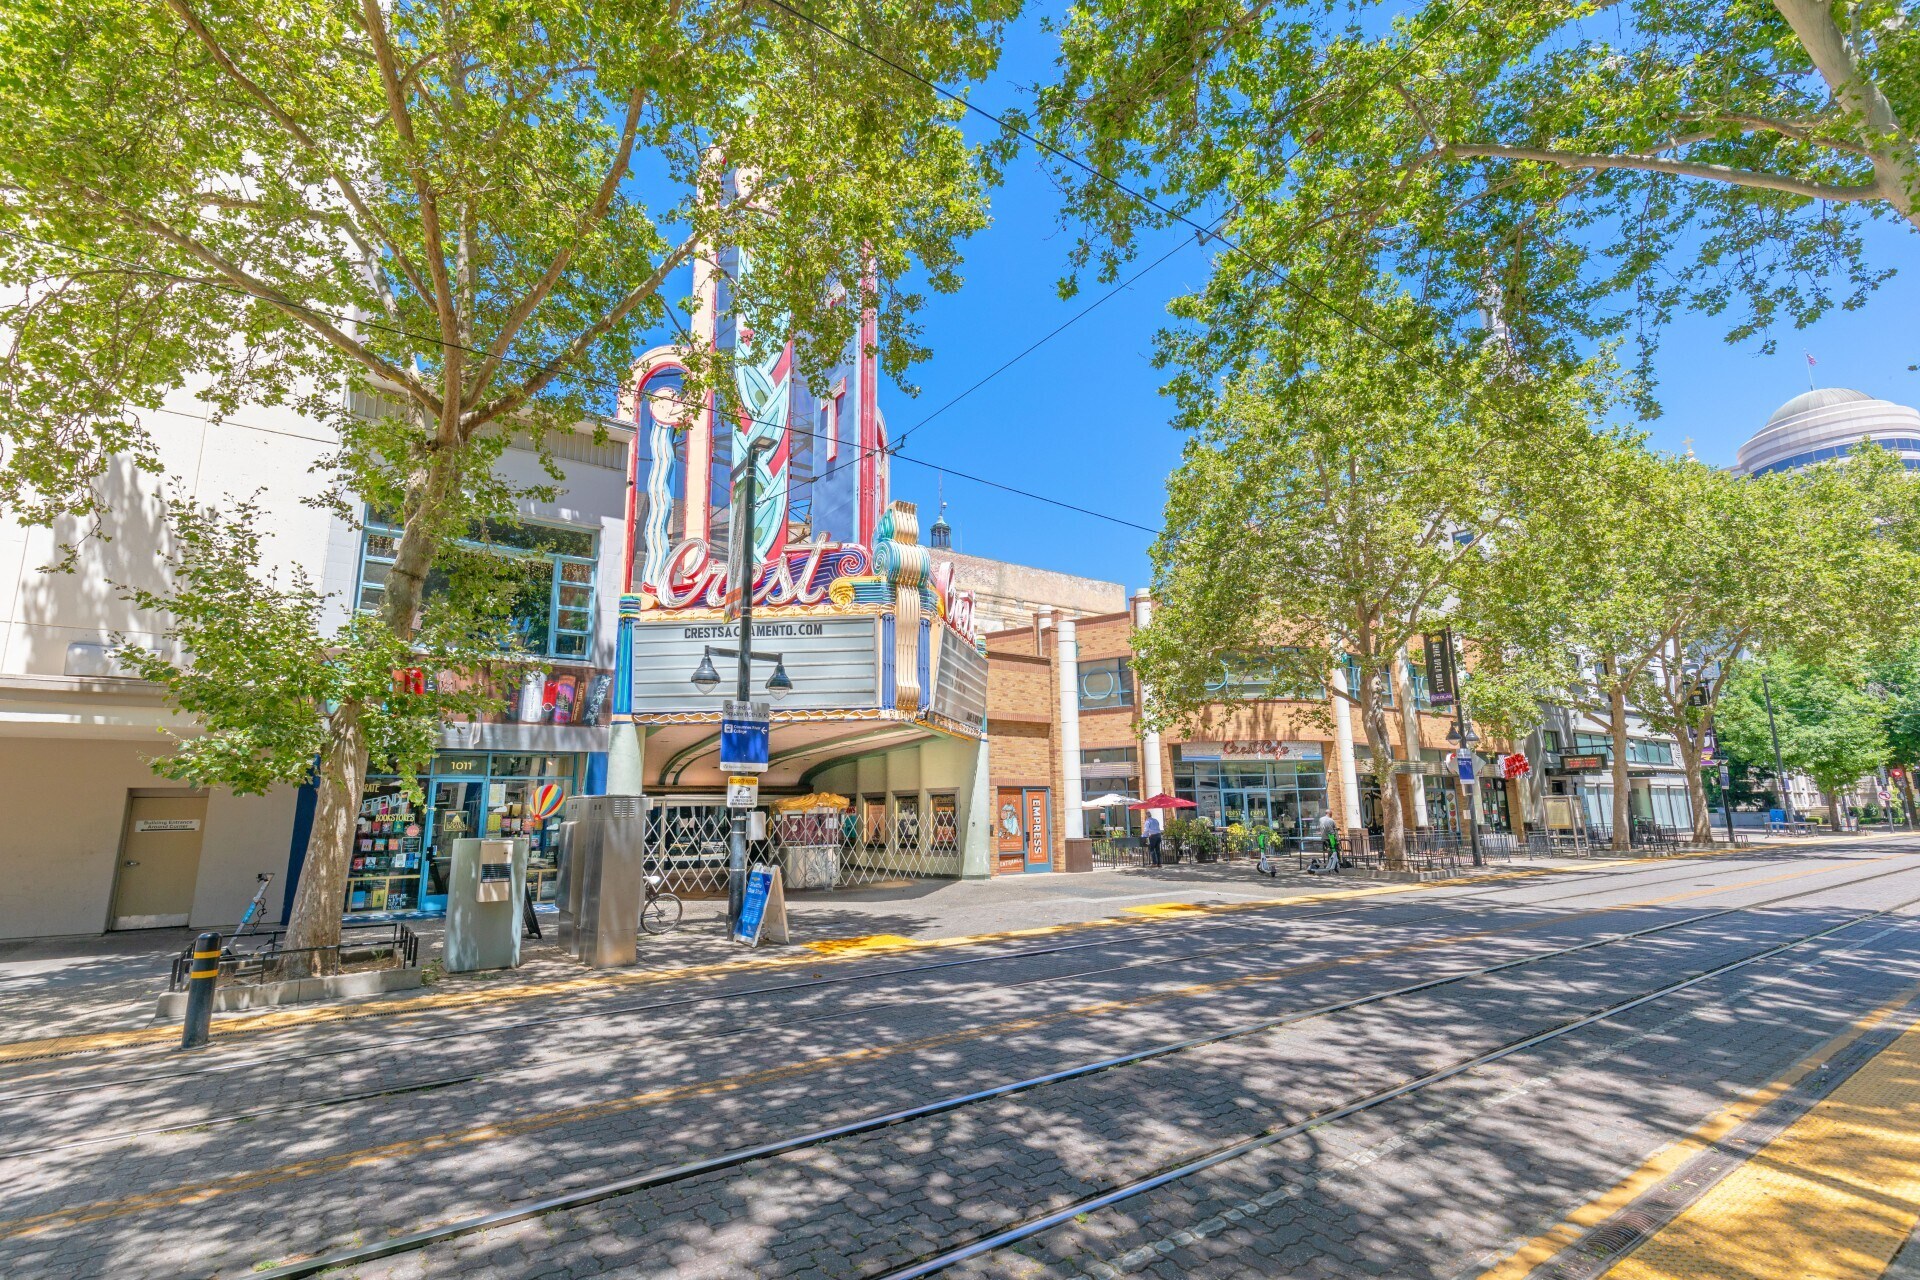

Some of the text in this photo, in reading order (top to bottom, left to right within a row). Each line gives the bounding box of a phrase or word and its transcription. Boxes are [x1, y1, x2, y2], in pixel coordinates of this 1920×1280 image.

[684, 623, 823, 639] CRESTSACAMENTO.COM
[725, 703, 753, 711] Cathedral
[725, 710, 744, 718] Square
[451, 761, 472, 770] 1011
[363, 783, 380, 793] RATE
[359, 791, 411, 813] DEPENDE
[375, 814, 415, 822] BOOKSTORES
[1032, 799, 1042, 855] EMPRESS
[1000, 858, 1023, 867] ENTRANCE
